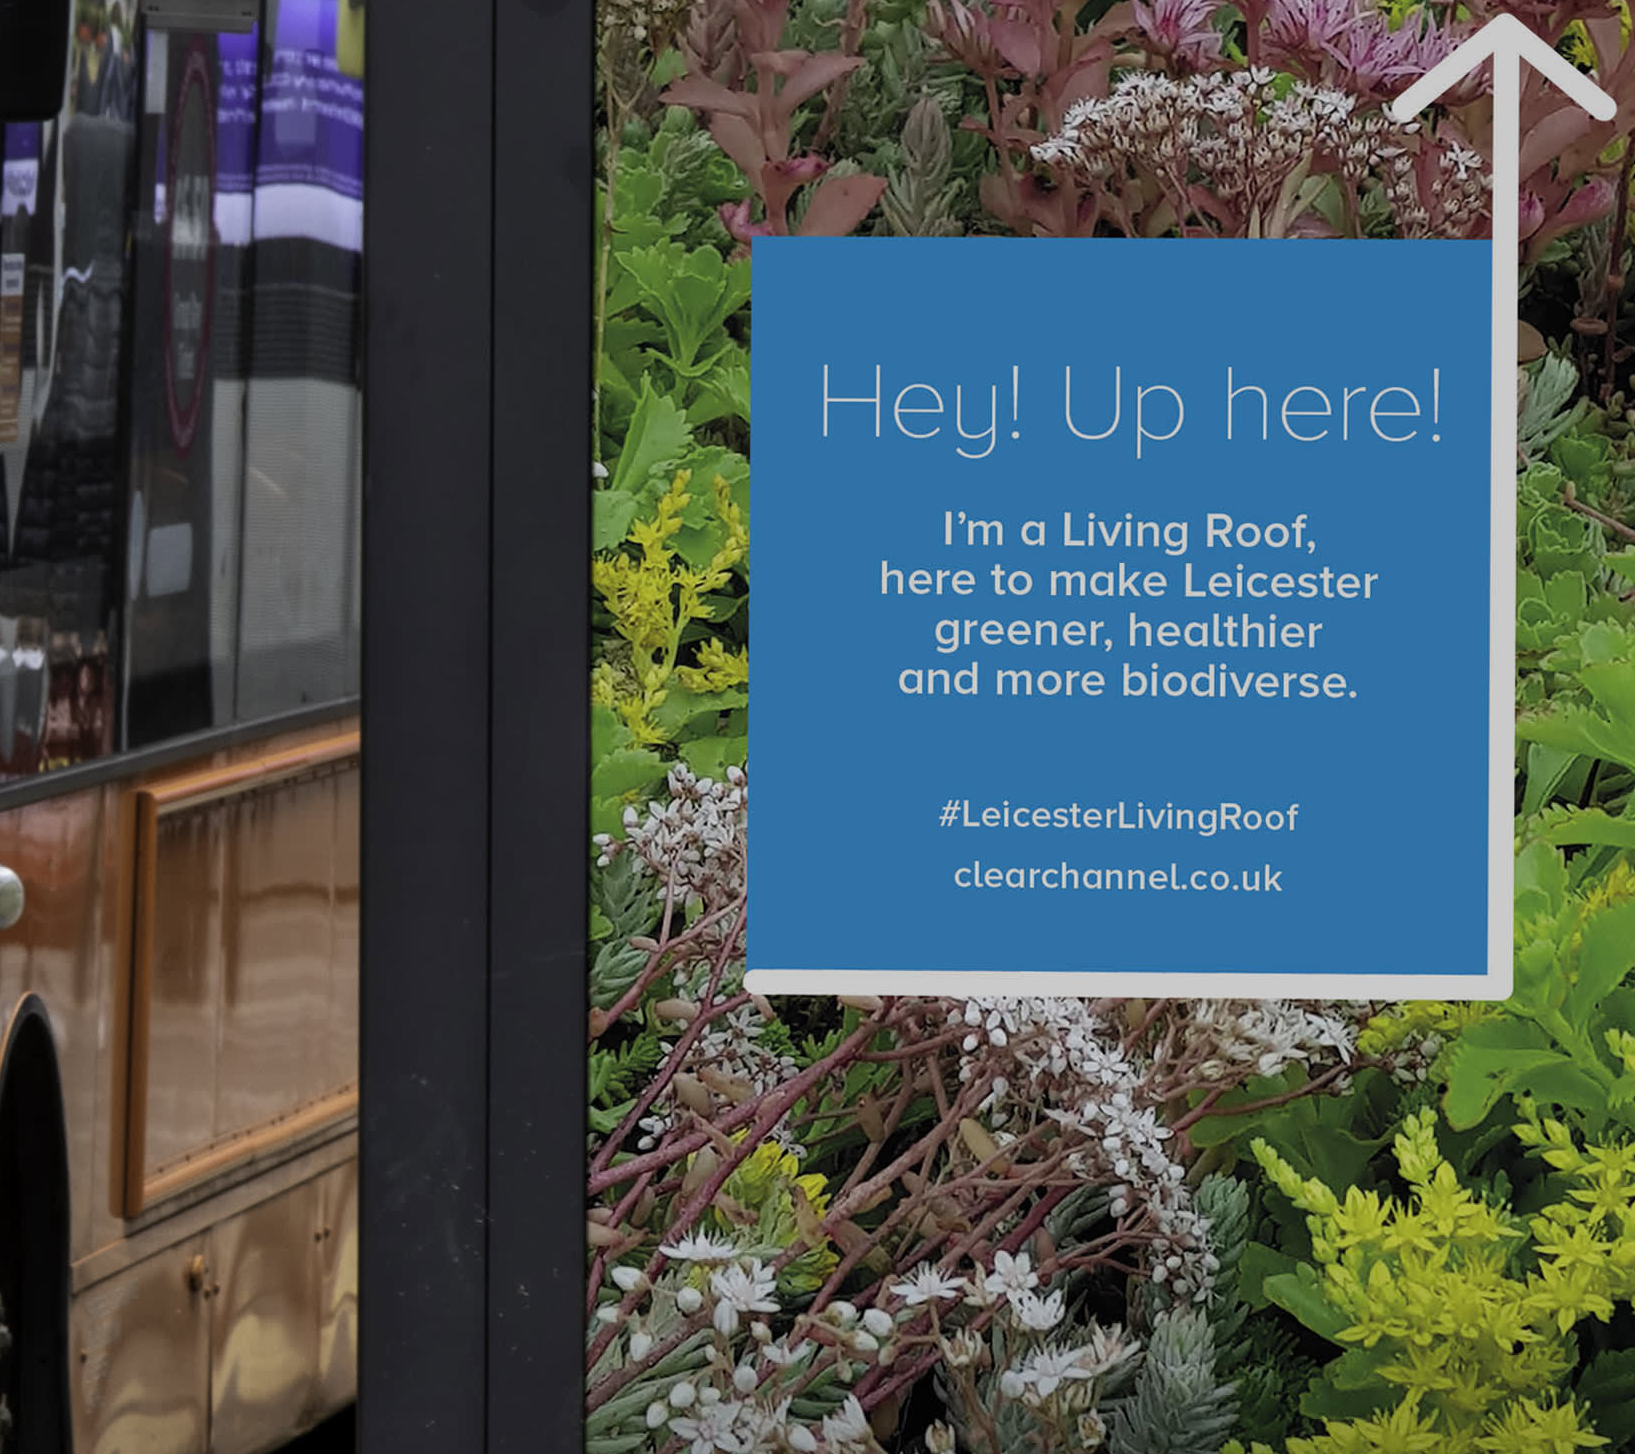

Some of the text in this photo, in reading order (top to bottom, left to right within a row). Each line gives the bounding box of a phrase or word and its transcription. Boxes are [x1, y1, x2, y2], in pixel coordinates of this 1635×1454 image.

[823, 364, 1441, 460] Hey! Up here!
[943, 511, 1316, 556] I'm a Living Roof,
[880, 560, 1379, 599] here to make Leicester
[934, 612, 1323, 654] greener, healthier
[898, 661, 1358, 699] and more biodiverse.
[938, 799, 1300, 837] #LeicesterLivingRoof
[954, 860, 1283, 892] clearchannel.co.uk
